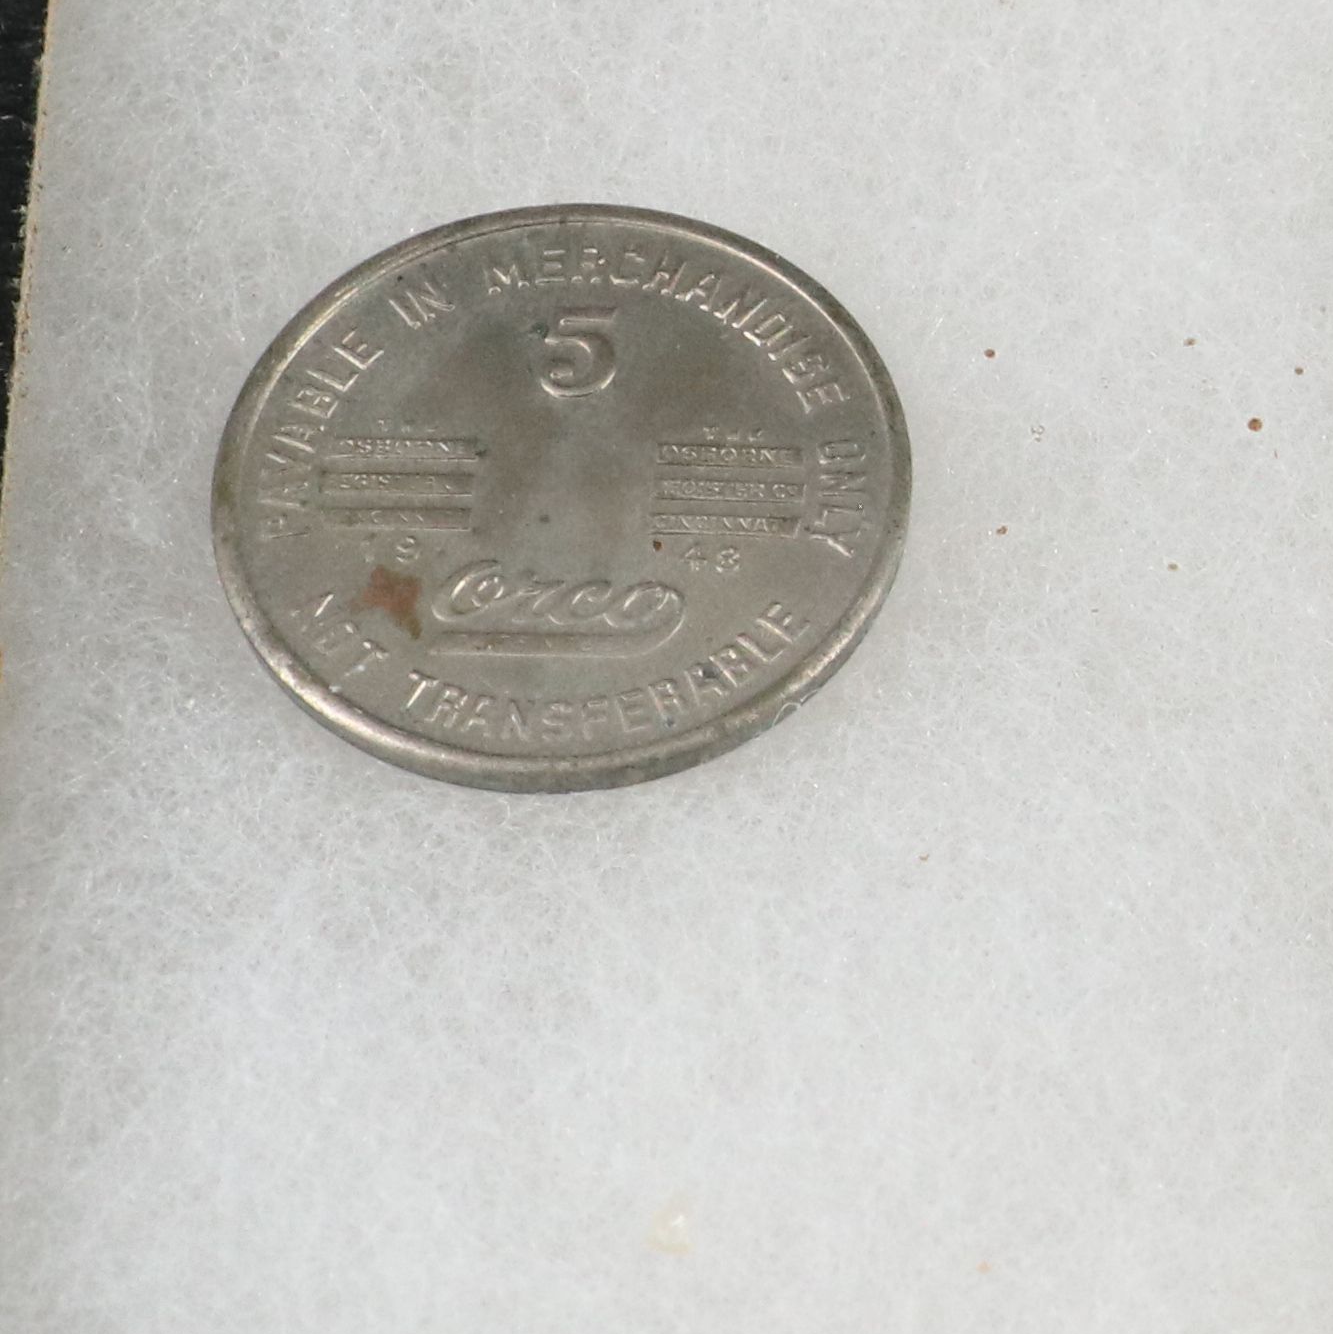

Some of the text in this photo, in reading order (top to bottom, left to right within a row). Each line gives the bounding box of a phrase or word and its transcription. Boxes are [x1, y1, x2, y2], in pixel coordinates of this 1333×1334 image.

[387, 279, 457, 331] IN
[483, 246, 851, 415] MERCHANDISE
[808, 438, 870, 560] ONLY
[540, 304, 620, 399] 5
[403, 601, 802, 743] TRANSFERABLE
